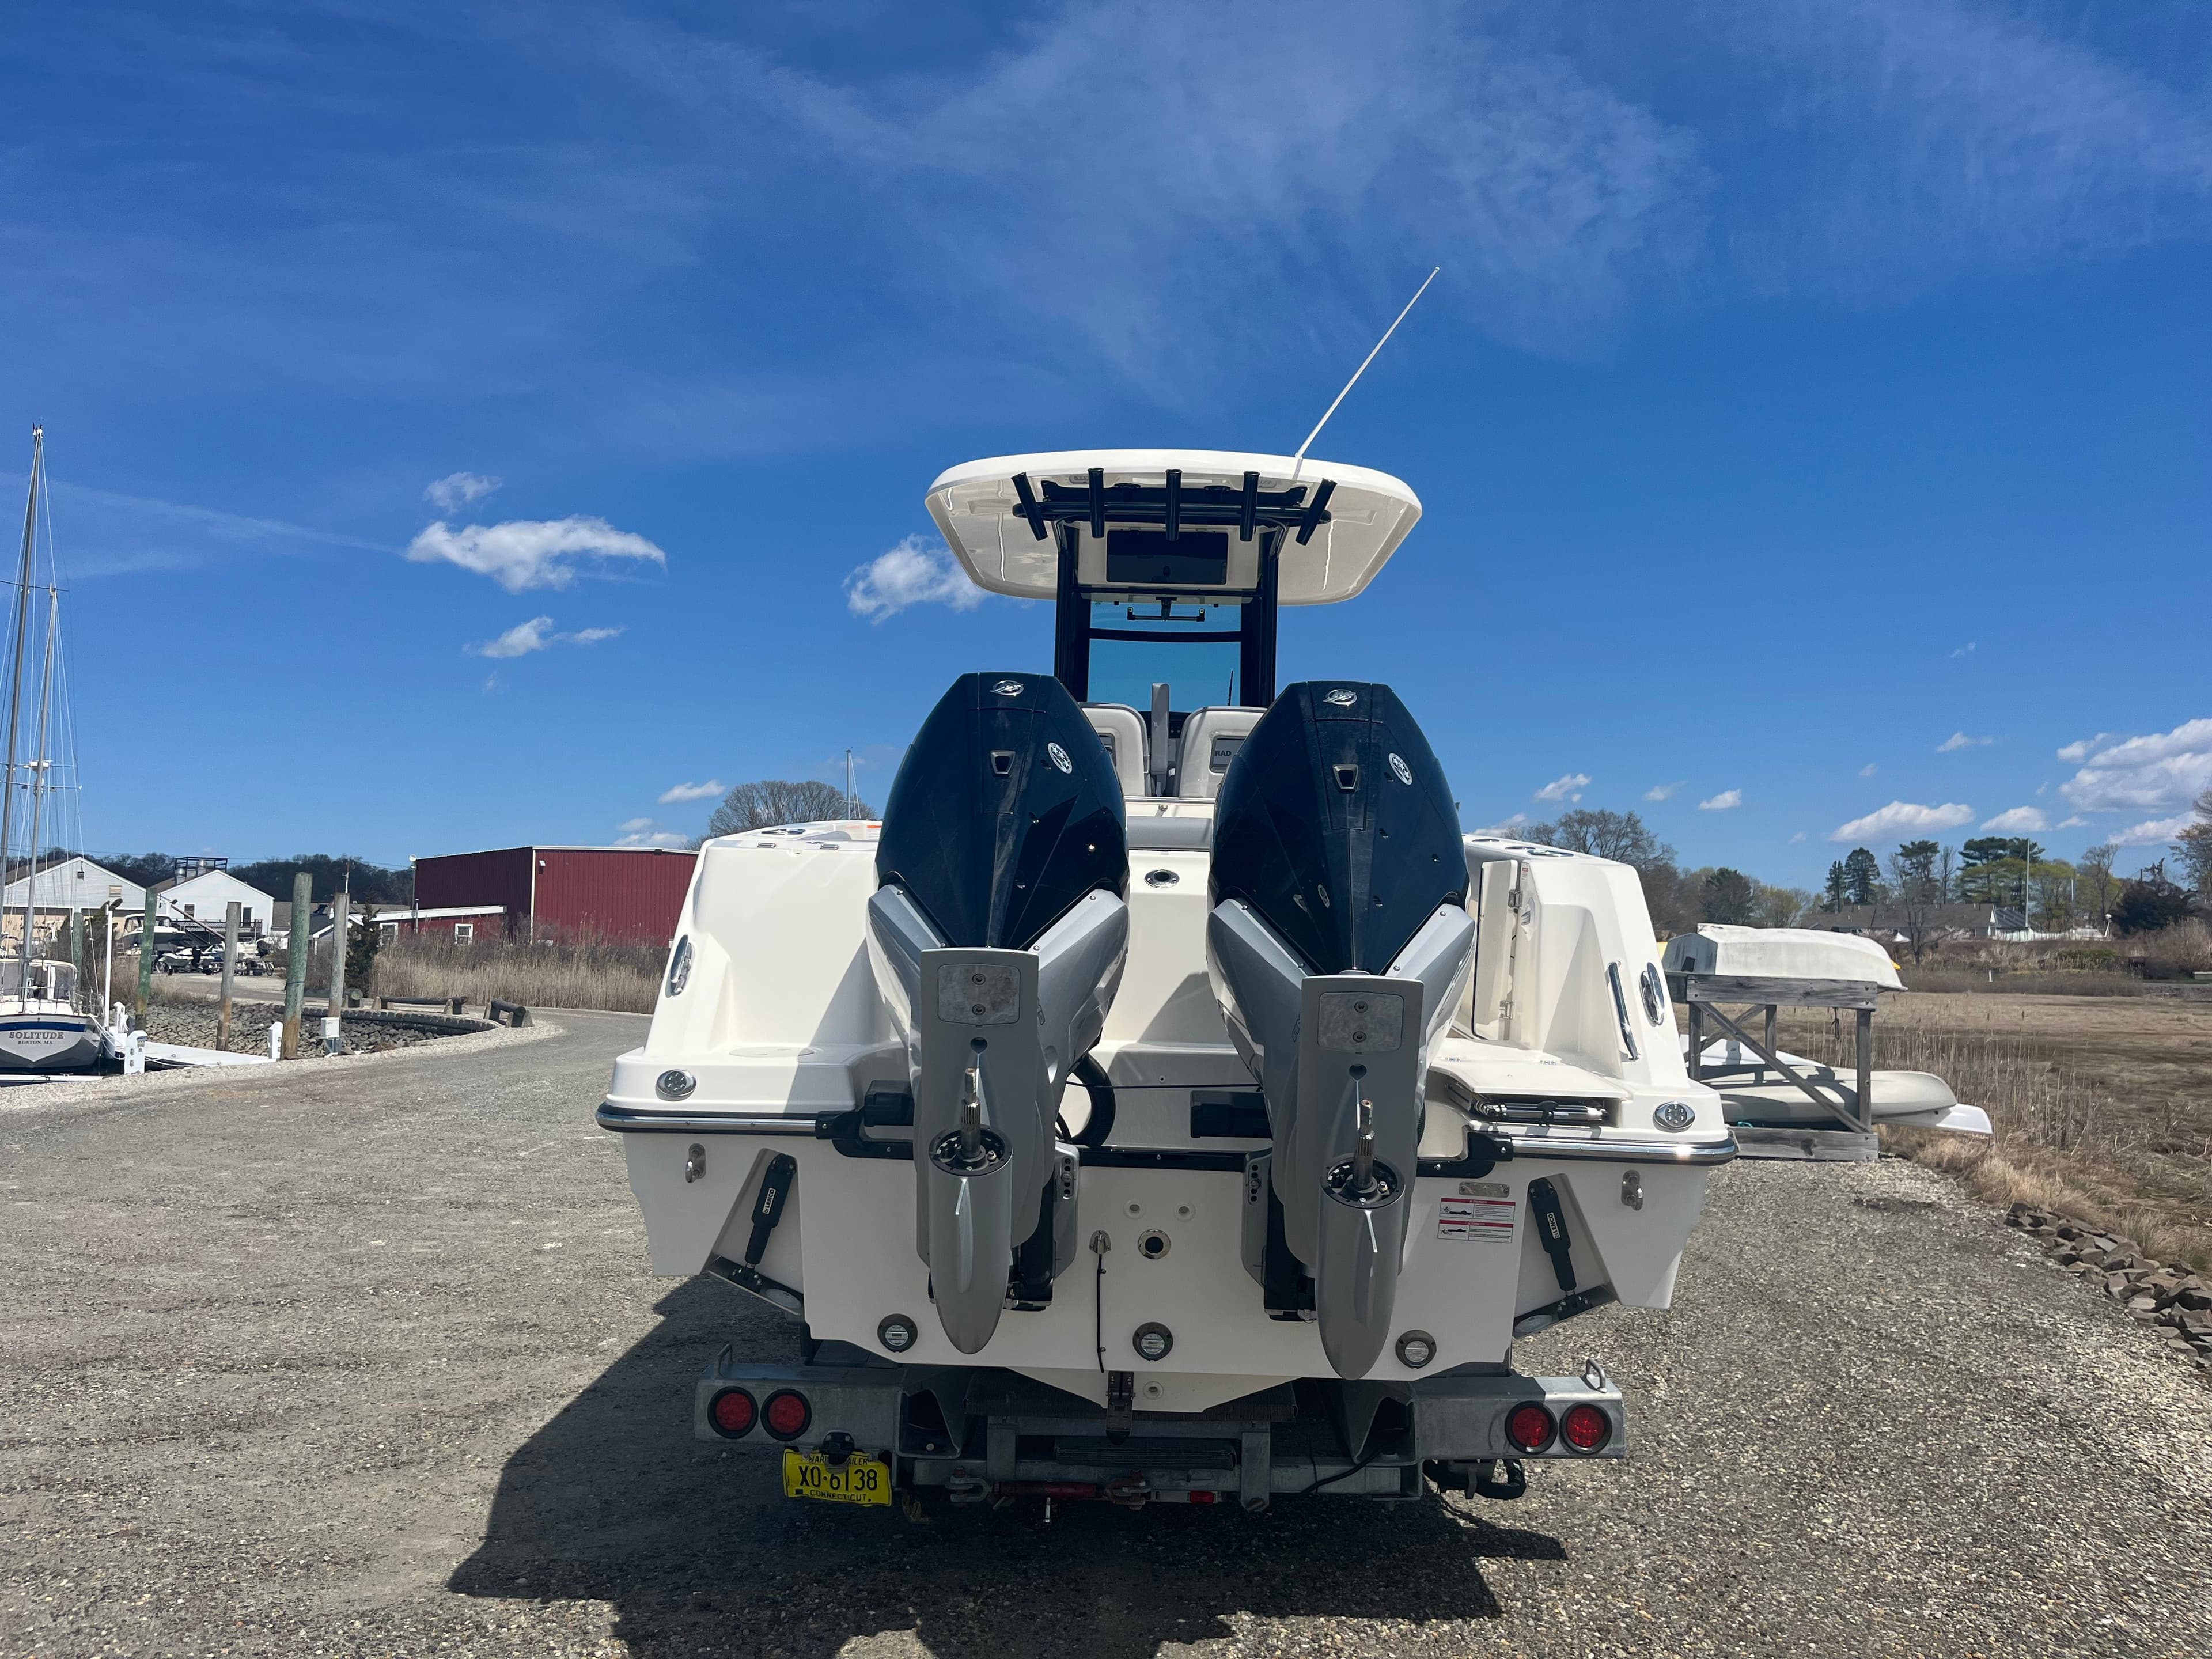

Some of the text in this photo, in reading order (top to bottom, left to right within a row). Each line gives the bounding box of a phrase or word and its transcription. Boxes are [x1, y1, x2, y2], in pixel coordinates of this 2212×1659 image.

[765, 1189, 774, 1208] LENCO
[1548, 1213, 1558, 1234] LENCO
[810, 1490, 867, 1501] CONNECTICUT
